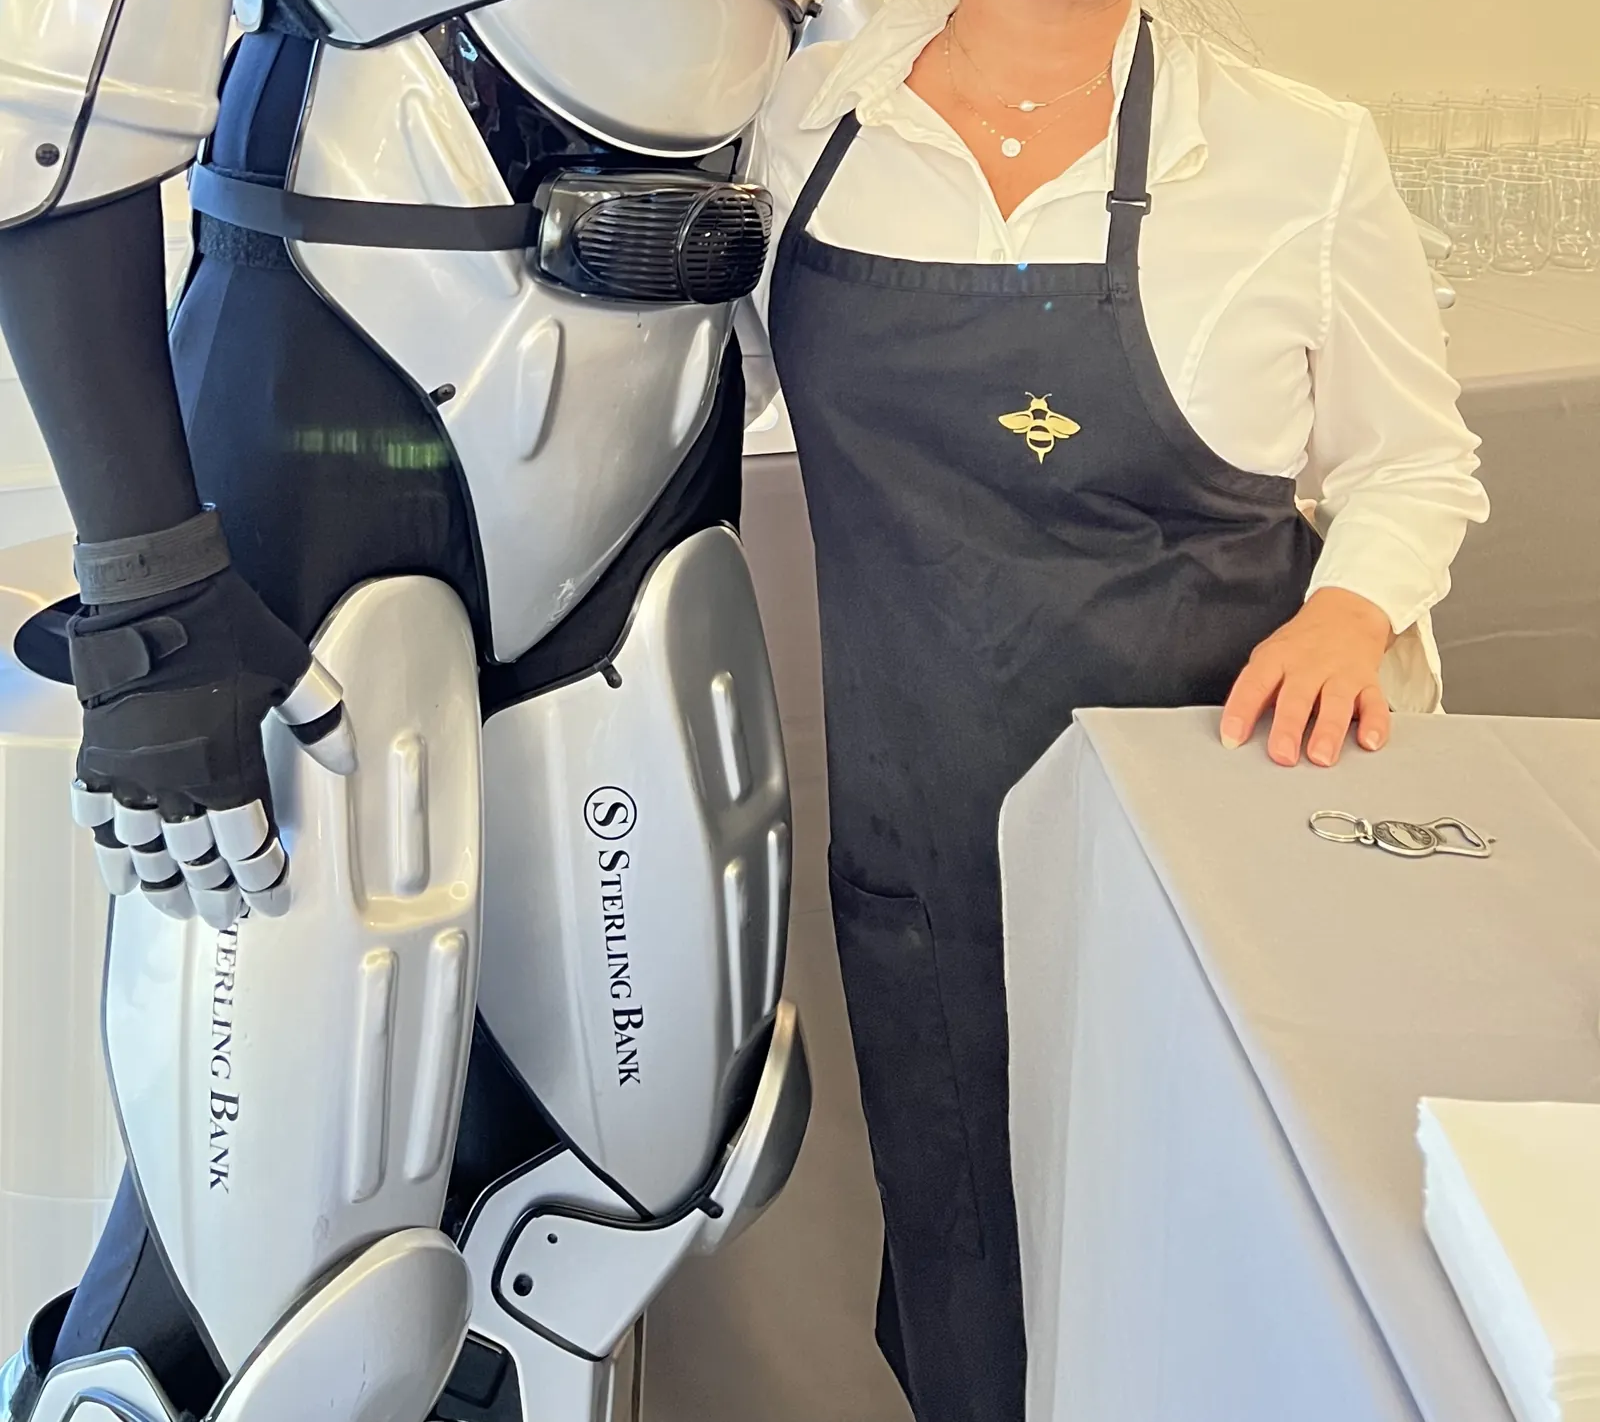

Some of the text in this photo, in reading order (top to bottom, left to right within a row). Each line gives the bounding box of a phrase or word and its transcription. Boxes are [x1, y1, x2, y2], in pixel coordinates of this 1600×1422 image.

[598, 850, 632, 999] STERLING
[209, 905, 250, 1194] TERLING BANK
[612, 1004, 645, 1087] BANK
